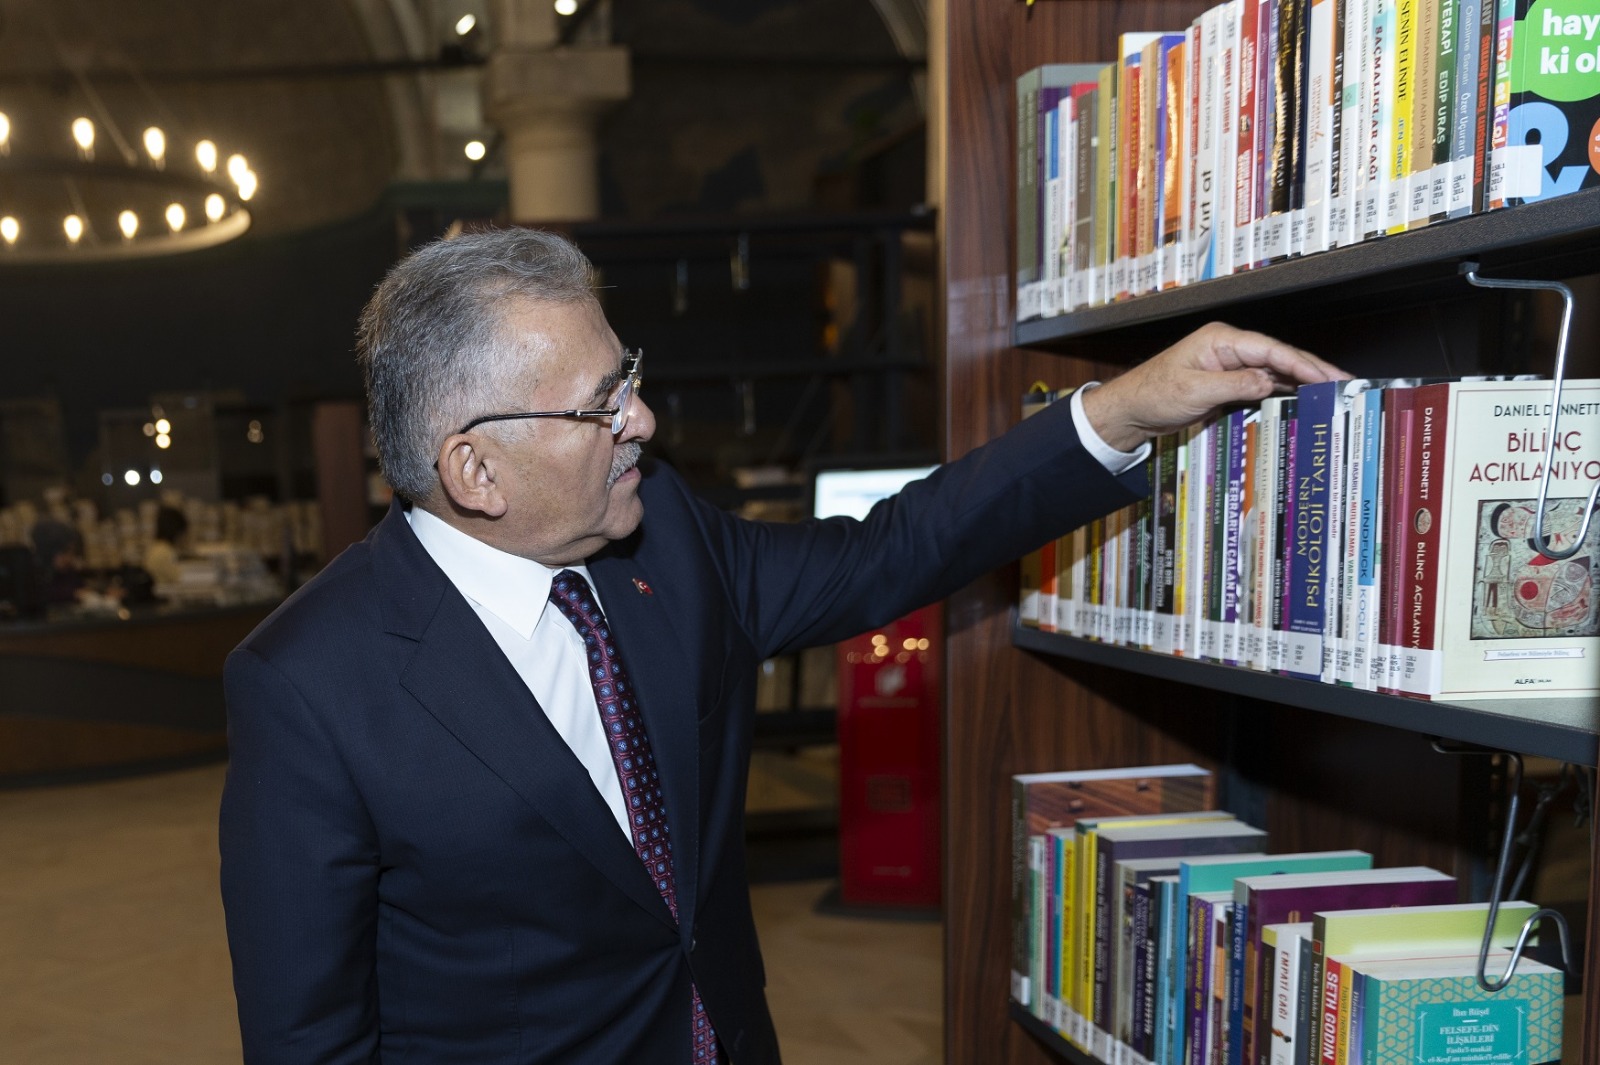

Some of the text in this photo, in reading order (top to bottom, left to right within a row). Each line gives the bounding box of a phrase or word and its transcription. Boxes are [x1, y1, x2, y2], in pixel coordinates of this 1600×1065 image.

[1461, 5, 1474, 85] Olabilme Sanatı
[1542, 8, 1600, 41] hay
[1496, 25, 1512, 79] hayal
[1540, 45, 1569, 75] ki
[1435, 69, 1449, 144] EDİP URAS
[1494, 81, 1507, 101] et
[1456, 92, 1470, 152] Özer Uçuran
[1197, 168, 1211, 238] Yırt at
[1366, 410, 1374, 434] Petra
[1494, 404, 1540, 417] DANIEL
[1312, 423, 1327, 495] TARİHİ
[1418, 406, 1434, 500] DANIEL DENNETT
[1297, 476, 1310, 557] MODERN
[1348, 502, 1357, 526] MUTLU
[1360, 499, 1371, 578] MINDFUCK
[1306, 503, 1325, 607] PSİKOLOJİ
[1347, 528, 1356, 557] OLMAYA
[1413, 541, 1427, 580] BİLİNÇ
[1225, 548, 1237, 596] ÇALAN
[1346, 560, 1354, 579] VAR
[1276, 950, 1290, 1019] EMPATİ ÇAĞI
[1339, 985, 1349, 1013] hayat
[1321, 971, 1339, 1059] SETH GODIN
[1440, 1024, 1500, 1035] FELSEFE-DİN
